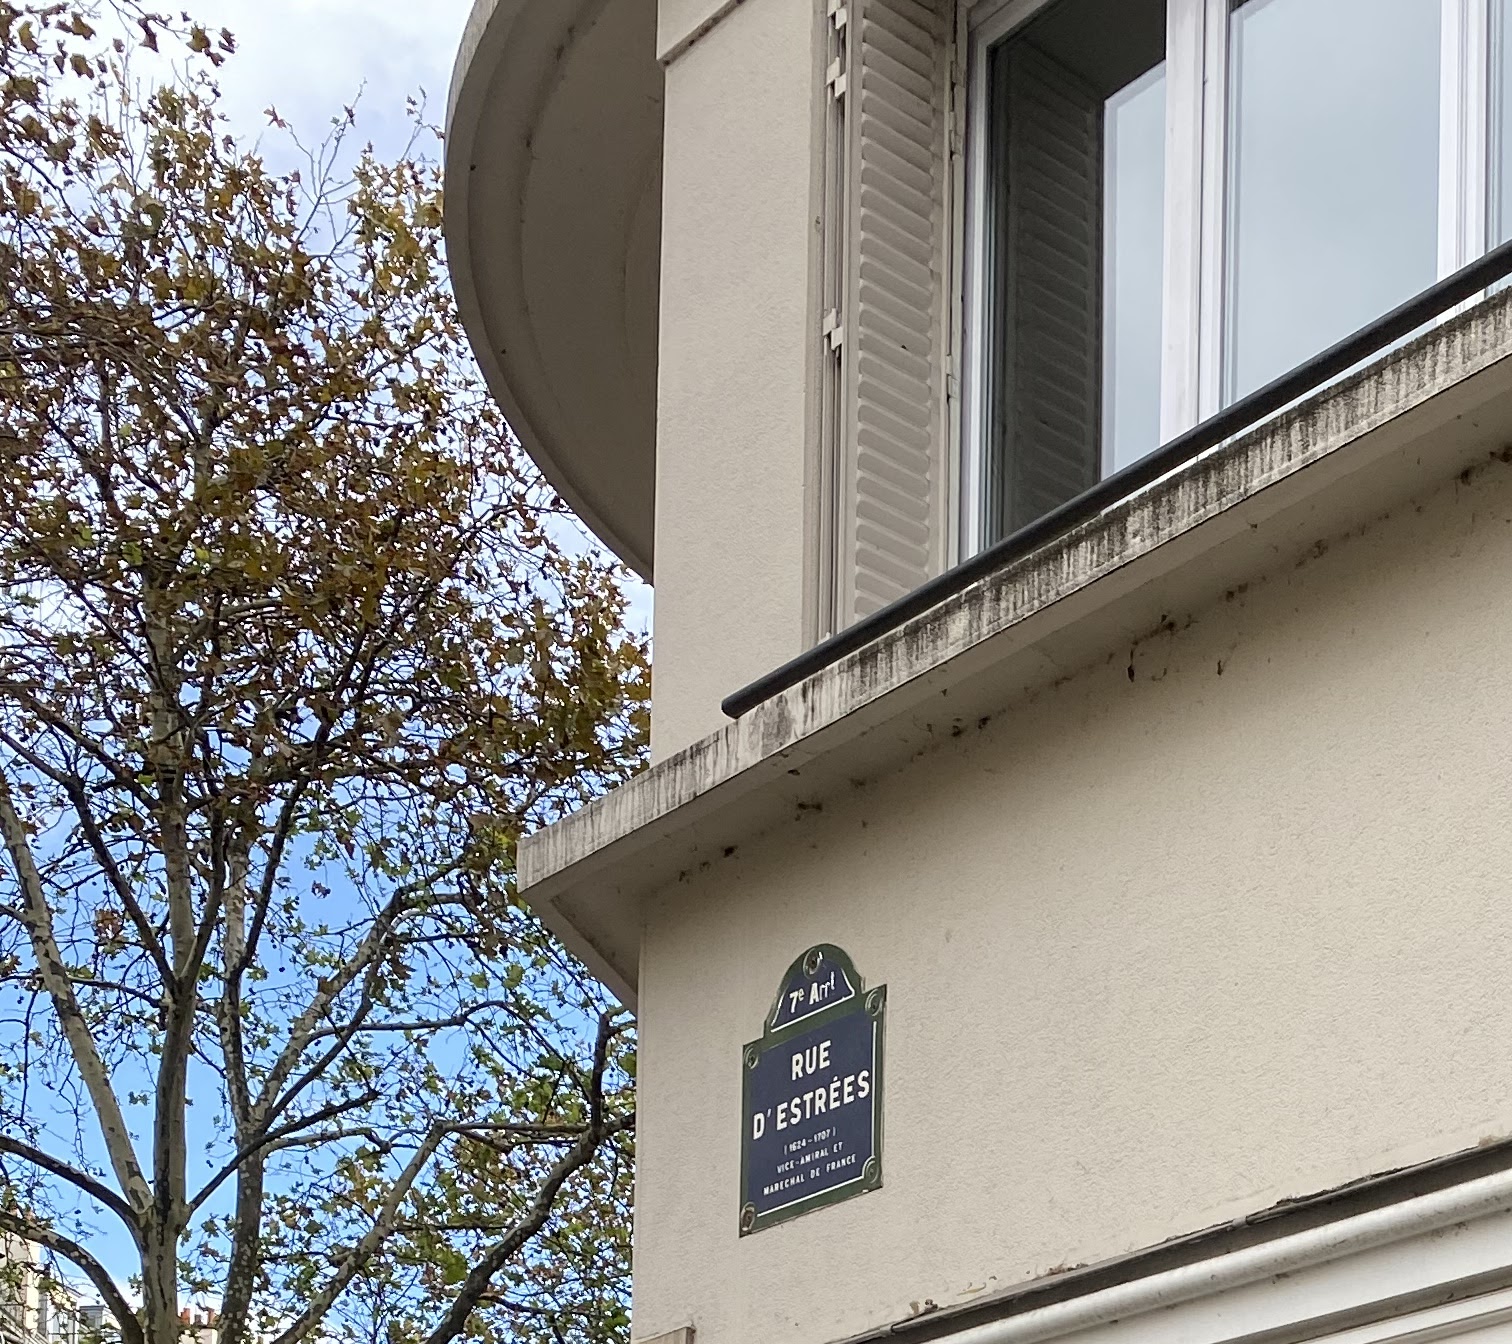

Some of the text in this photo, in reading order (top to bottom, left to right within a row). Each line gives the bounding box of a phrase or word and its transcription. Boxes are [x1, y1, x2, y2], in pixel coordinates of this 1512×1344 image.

[791, 1040, 832, 1081] RUE
[753, 1069, 870, 1141] D'ESTRÉES
[777, 1141, 843, 1174] VICE-AMIRAL ET
[810, 1167, 820, 1179] DE
[826, 1154, 856, 1173] FRANCE
